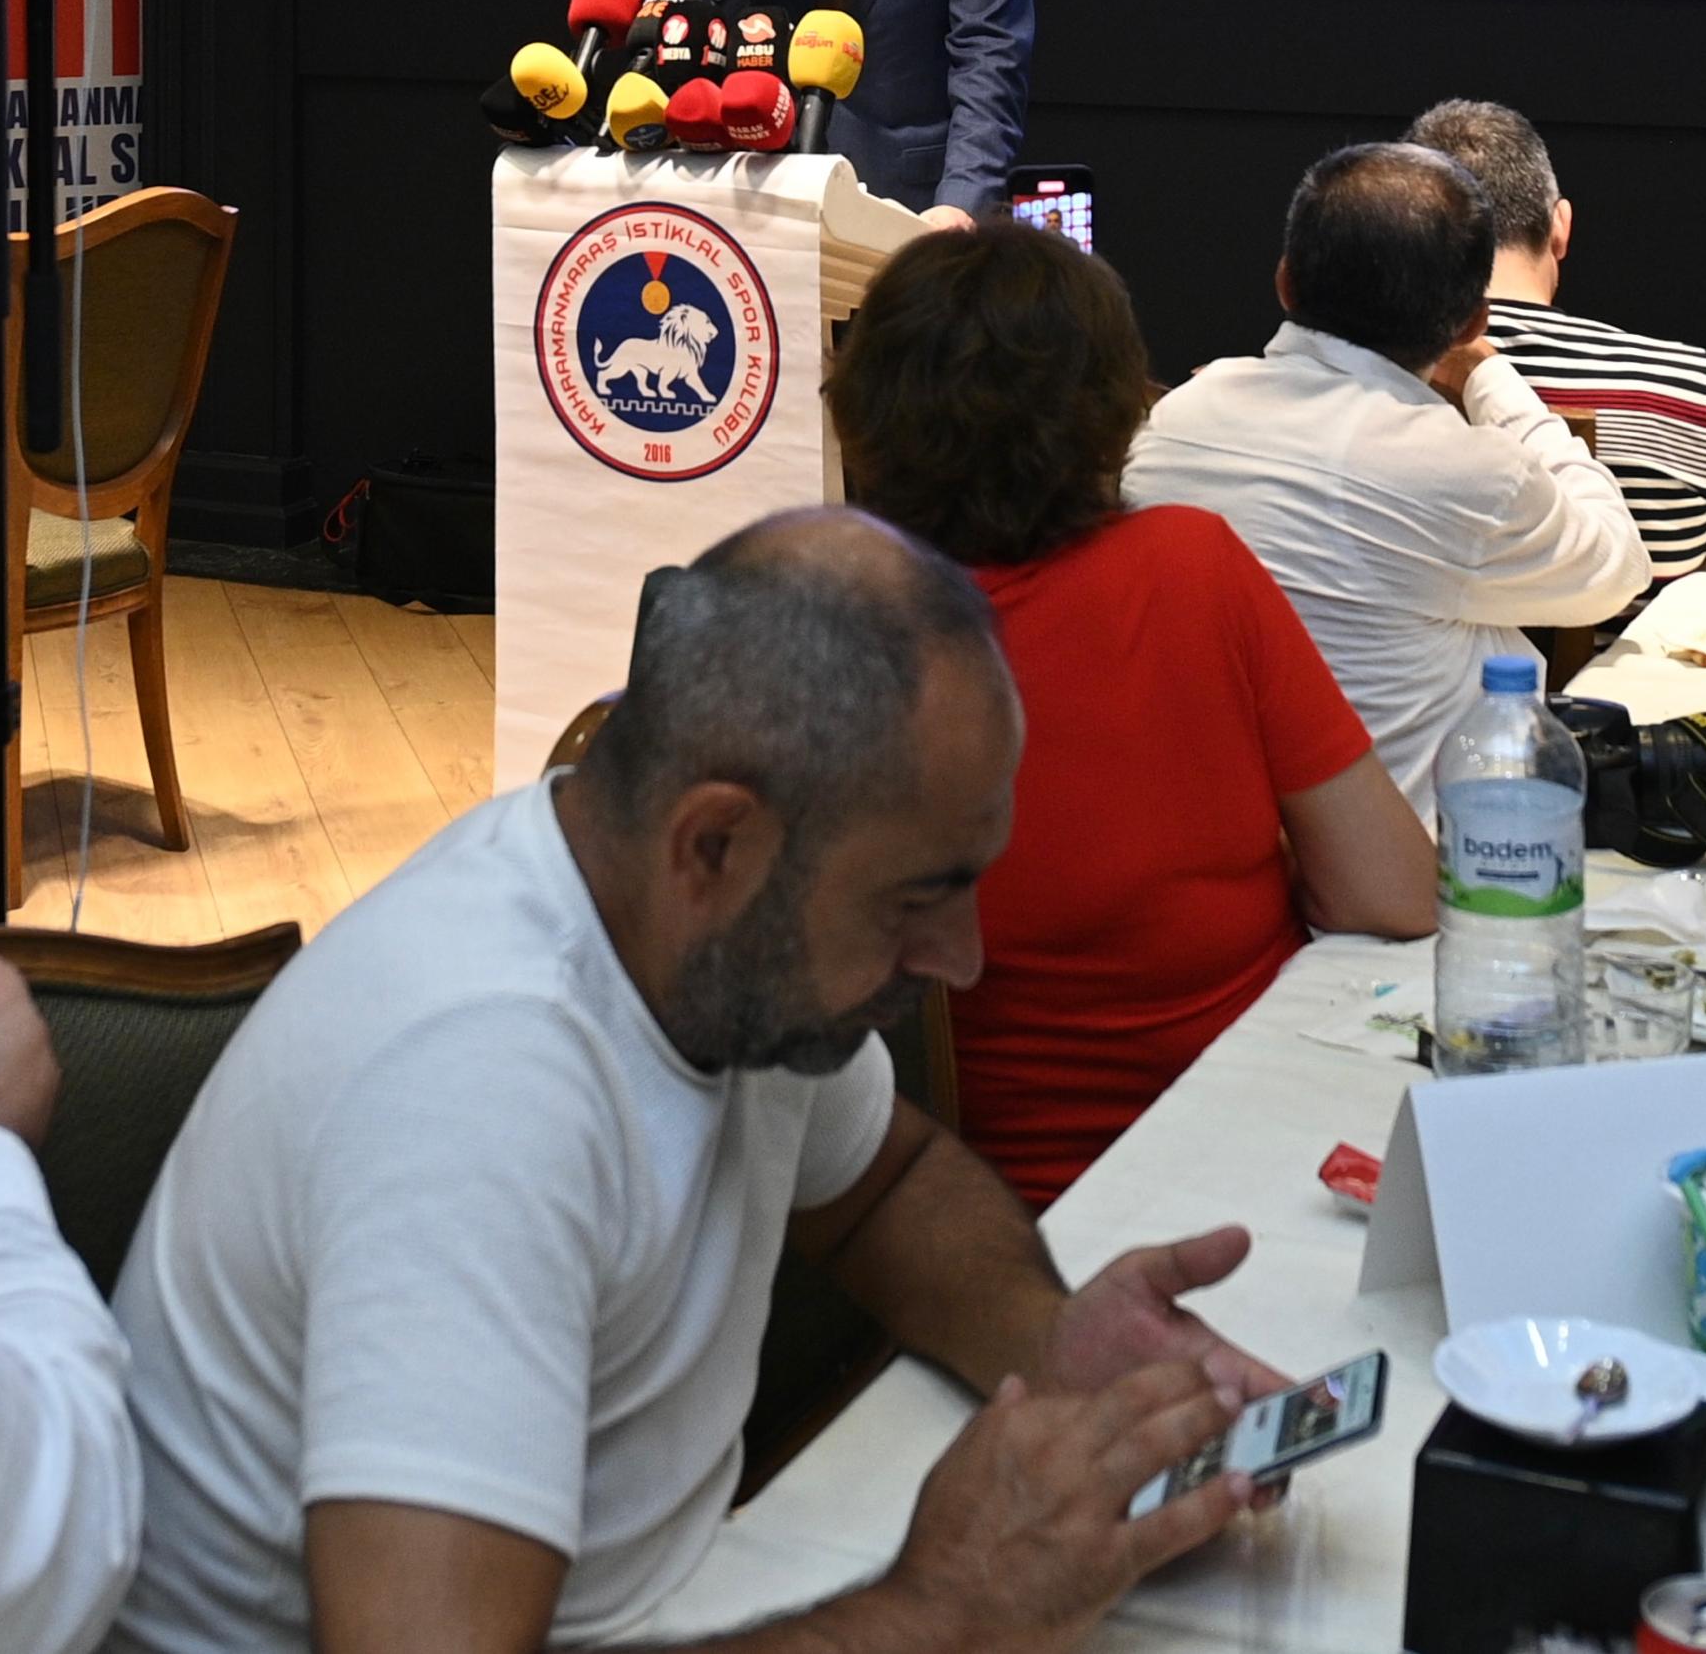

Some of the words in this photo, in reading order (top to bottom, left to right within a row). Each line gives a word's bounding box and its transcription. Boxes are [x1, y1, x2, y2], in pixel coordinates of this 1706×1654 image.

[736, 44, 774, 57] AKSU
[737, 56, 773, 68] HABER
[626, 219, 722, 267] İSTİKLAL
[726, 271, 762, 343] SPOR
[550, 232, 618, 437] KAHRAMANMARAŞ
[712, 353, 763, 446] KULÜBÜ
[644, 443, 672, 463] 2016
[1464, 836, 1553, 860] badem
